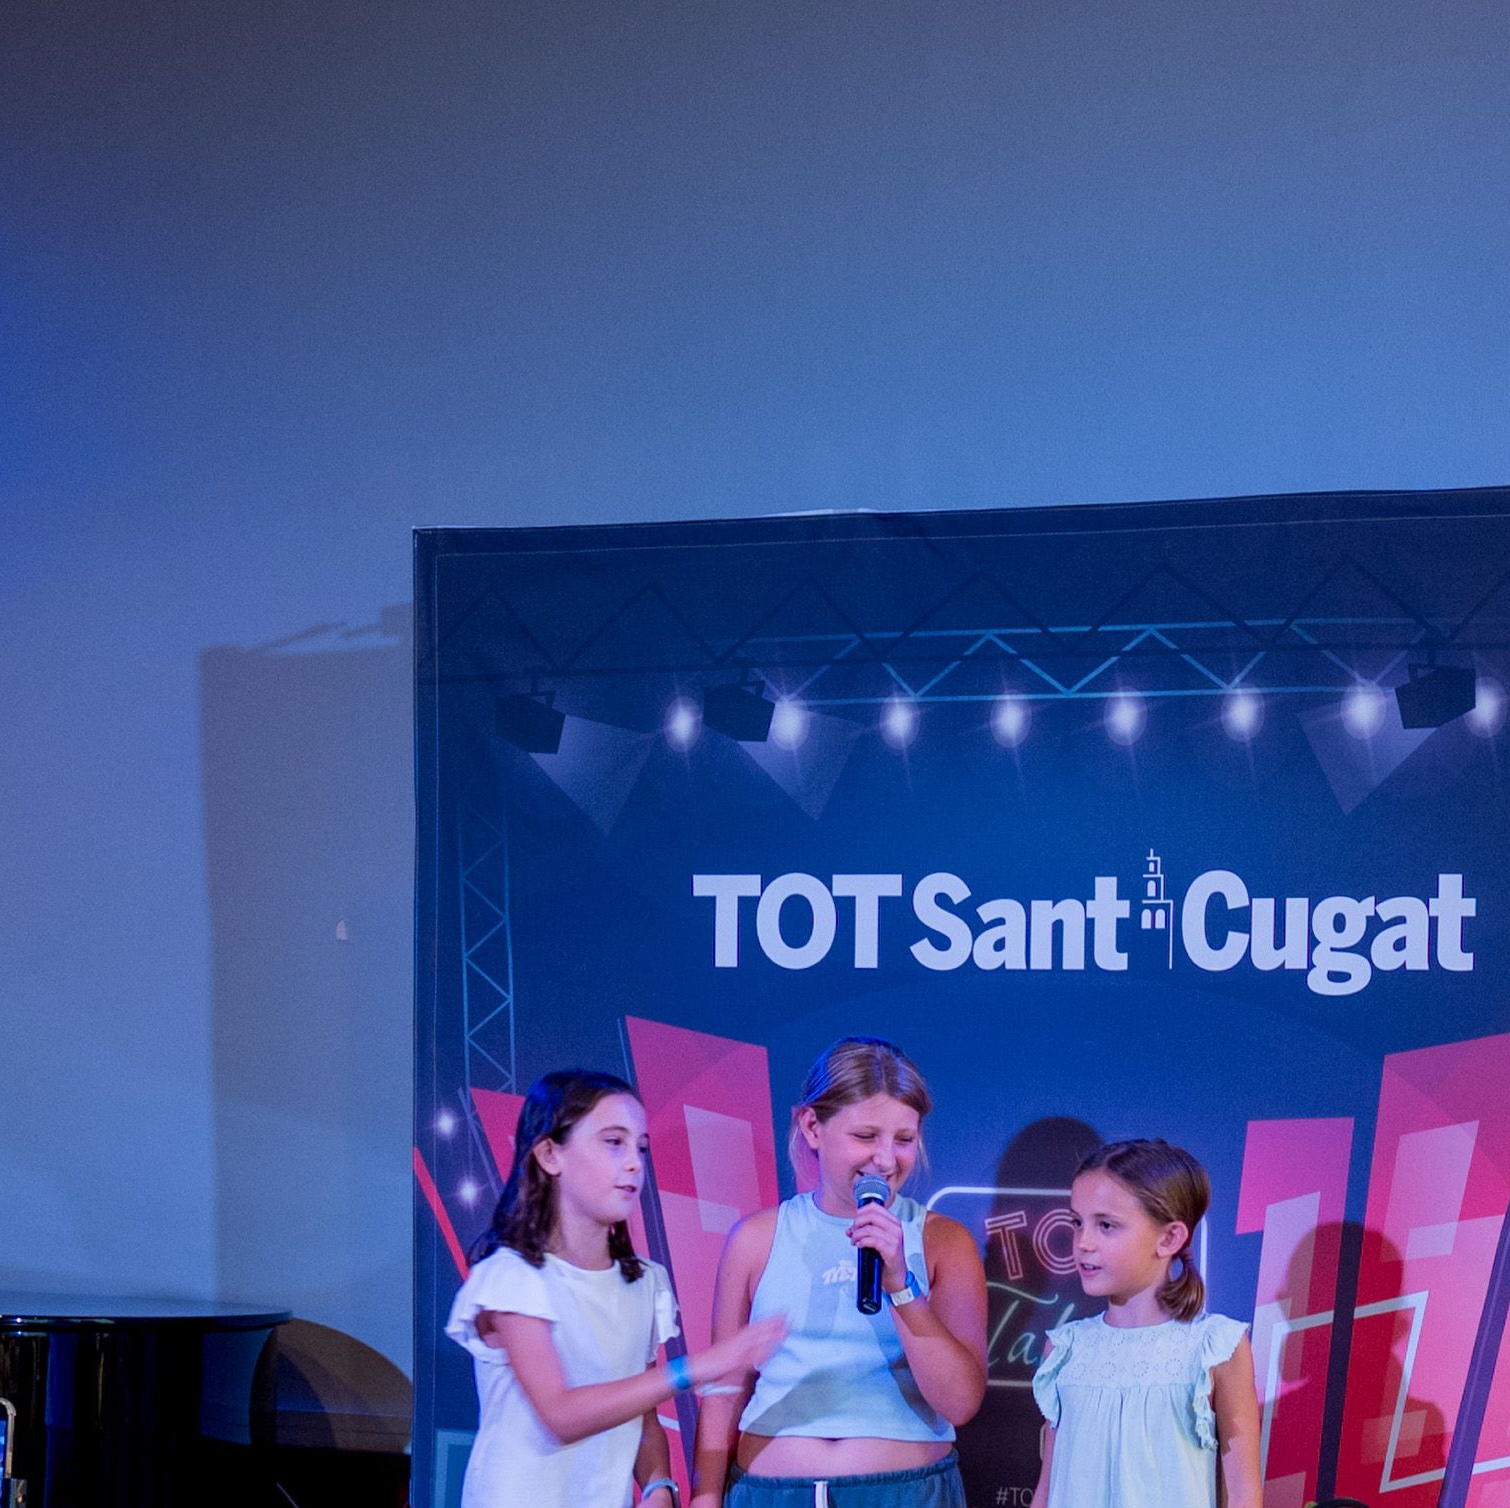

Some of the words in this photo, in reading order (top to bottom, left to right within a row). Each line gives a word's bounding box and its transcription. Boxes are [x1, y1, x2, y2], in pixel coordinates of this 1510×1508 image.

[693, 872, 903, 969] TOT
[910, 872, 1130, 971] Sant
[1182, 869, 1476, 996] Cugat
[984, 1208, 1079, 1280] TO
[996, 1487, 1036, 1508] #TO
